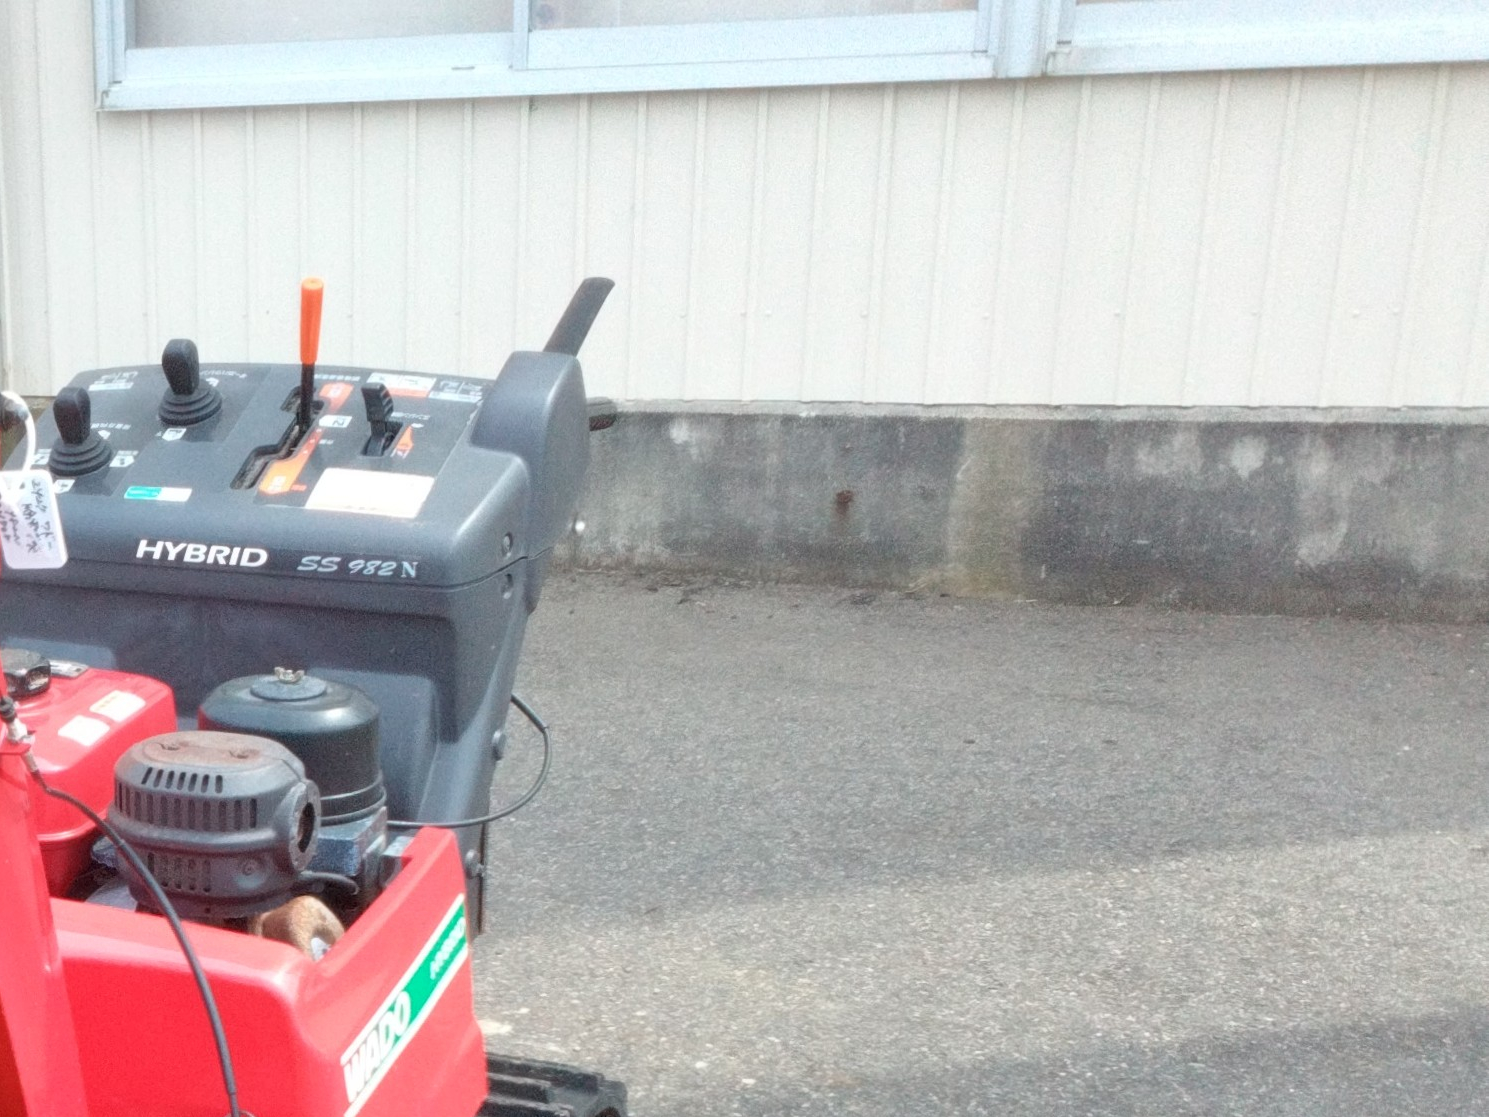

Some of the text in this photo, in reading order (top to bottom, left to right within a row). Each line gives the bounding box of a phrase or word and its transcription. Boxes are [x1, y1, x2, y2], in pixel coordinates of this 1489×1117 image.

[135, 539, 268, 567] HYBRID
[296, 555, 342, 573] SS
[343, 990, 412, 1104] WADO
